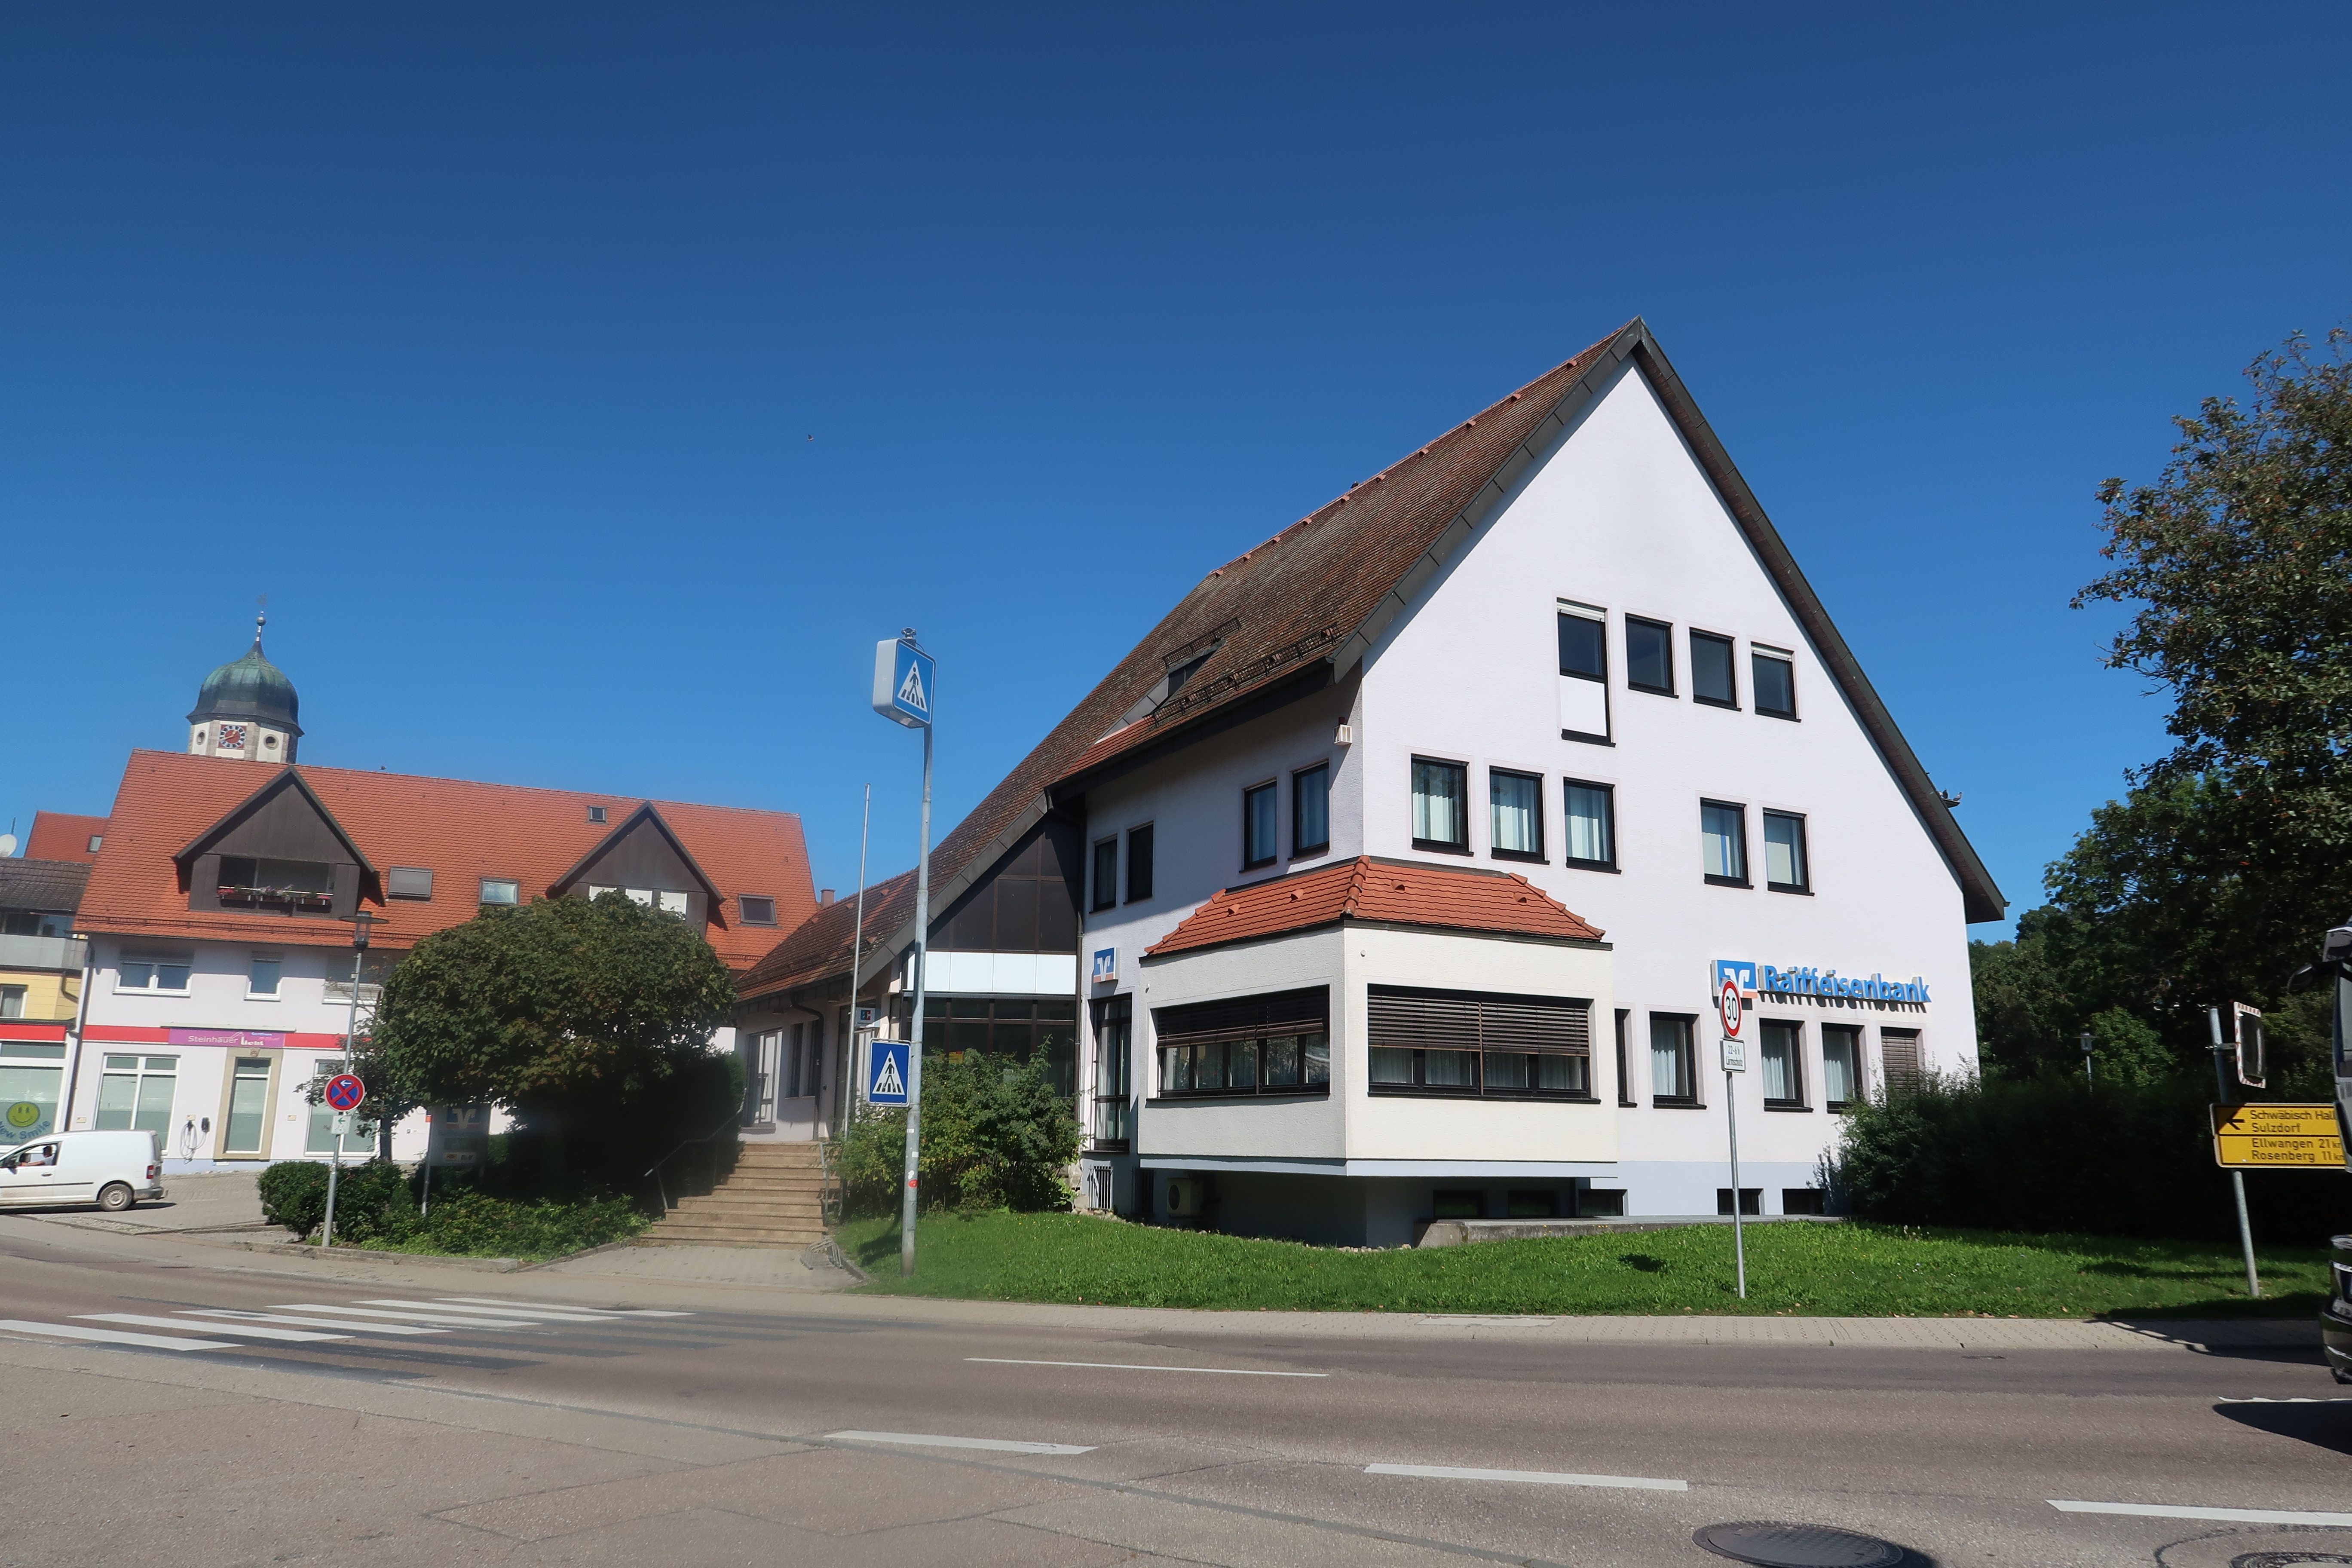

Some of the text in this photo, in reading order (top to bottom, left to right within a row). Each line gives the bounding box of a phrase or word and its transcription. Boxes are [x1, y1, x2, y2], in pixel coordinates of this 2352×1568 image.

[1758, 965, 1932, 1002] Raiffeisenbank
[1726, 995, 1737, 1021] 30
[2250, 1110, 2311, 1120] Schwäbisch
[2252, 1123, 2300, 1132] Sulzdorf
[2252, 1138, 2313, 1150] Ellwangen
[2318, 1139, 2330, 1148] 21
[2252, 1150, 2315, 1163] Rosenberg
[2322, 1151, 2331, 1161] 11
